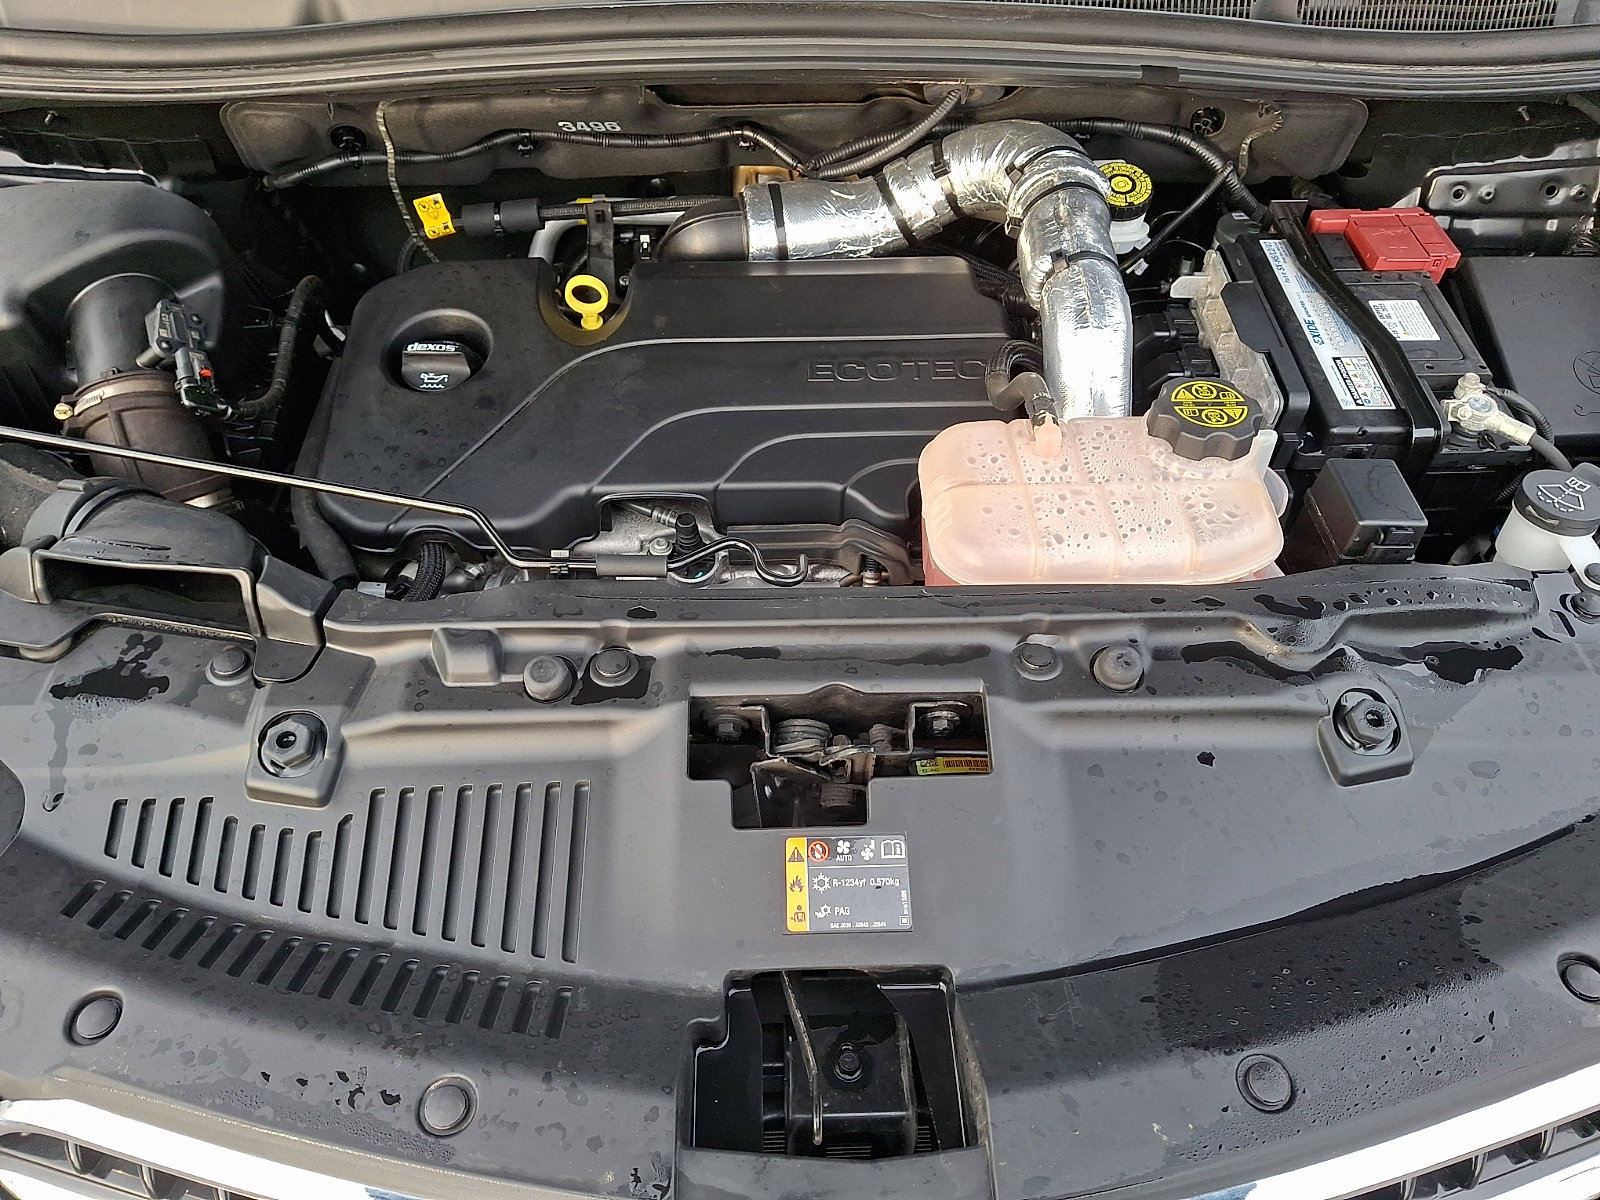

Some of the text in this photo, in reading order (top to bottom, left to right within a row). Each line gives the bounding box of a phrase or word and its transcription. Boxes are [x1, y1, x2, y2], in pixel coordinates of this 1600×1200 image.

[557, 121, 621, 132] 3496
[1303, 317, 1325, 345] EXIDE
[407, 342, 459, 352] dexos
[807, 359, 987, 382] ECOTEC
[836, 854, 853, 862] AUTO
[832, 877, 900, 888] R-1234yf 0.570kg
[834, 906, 850, 916] PAG
